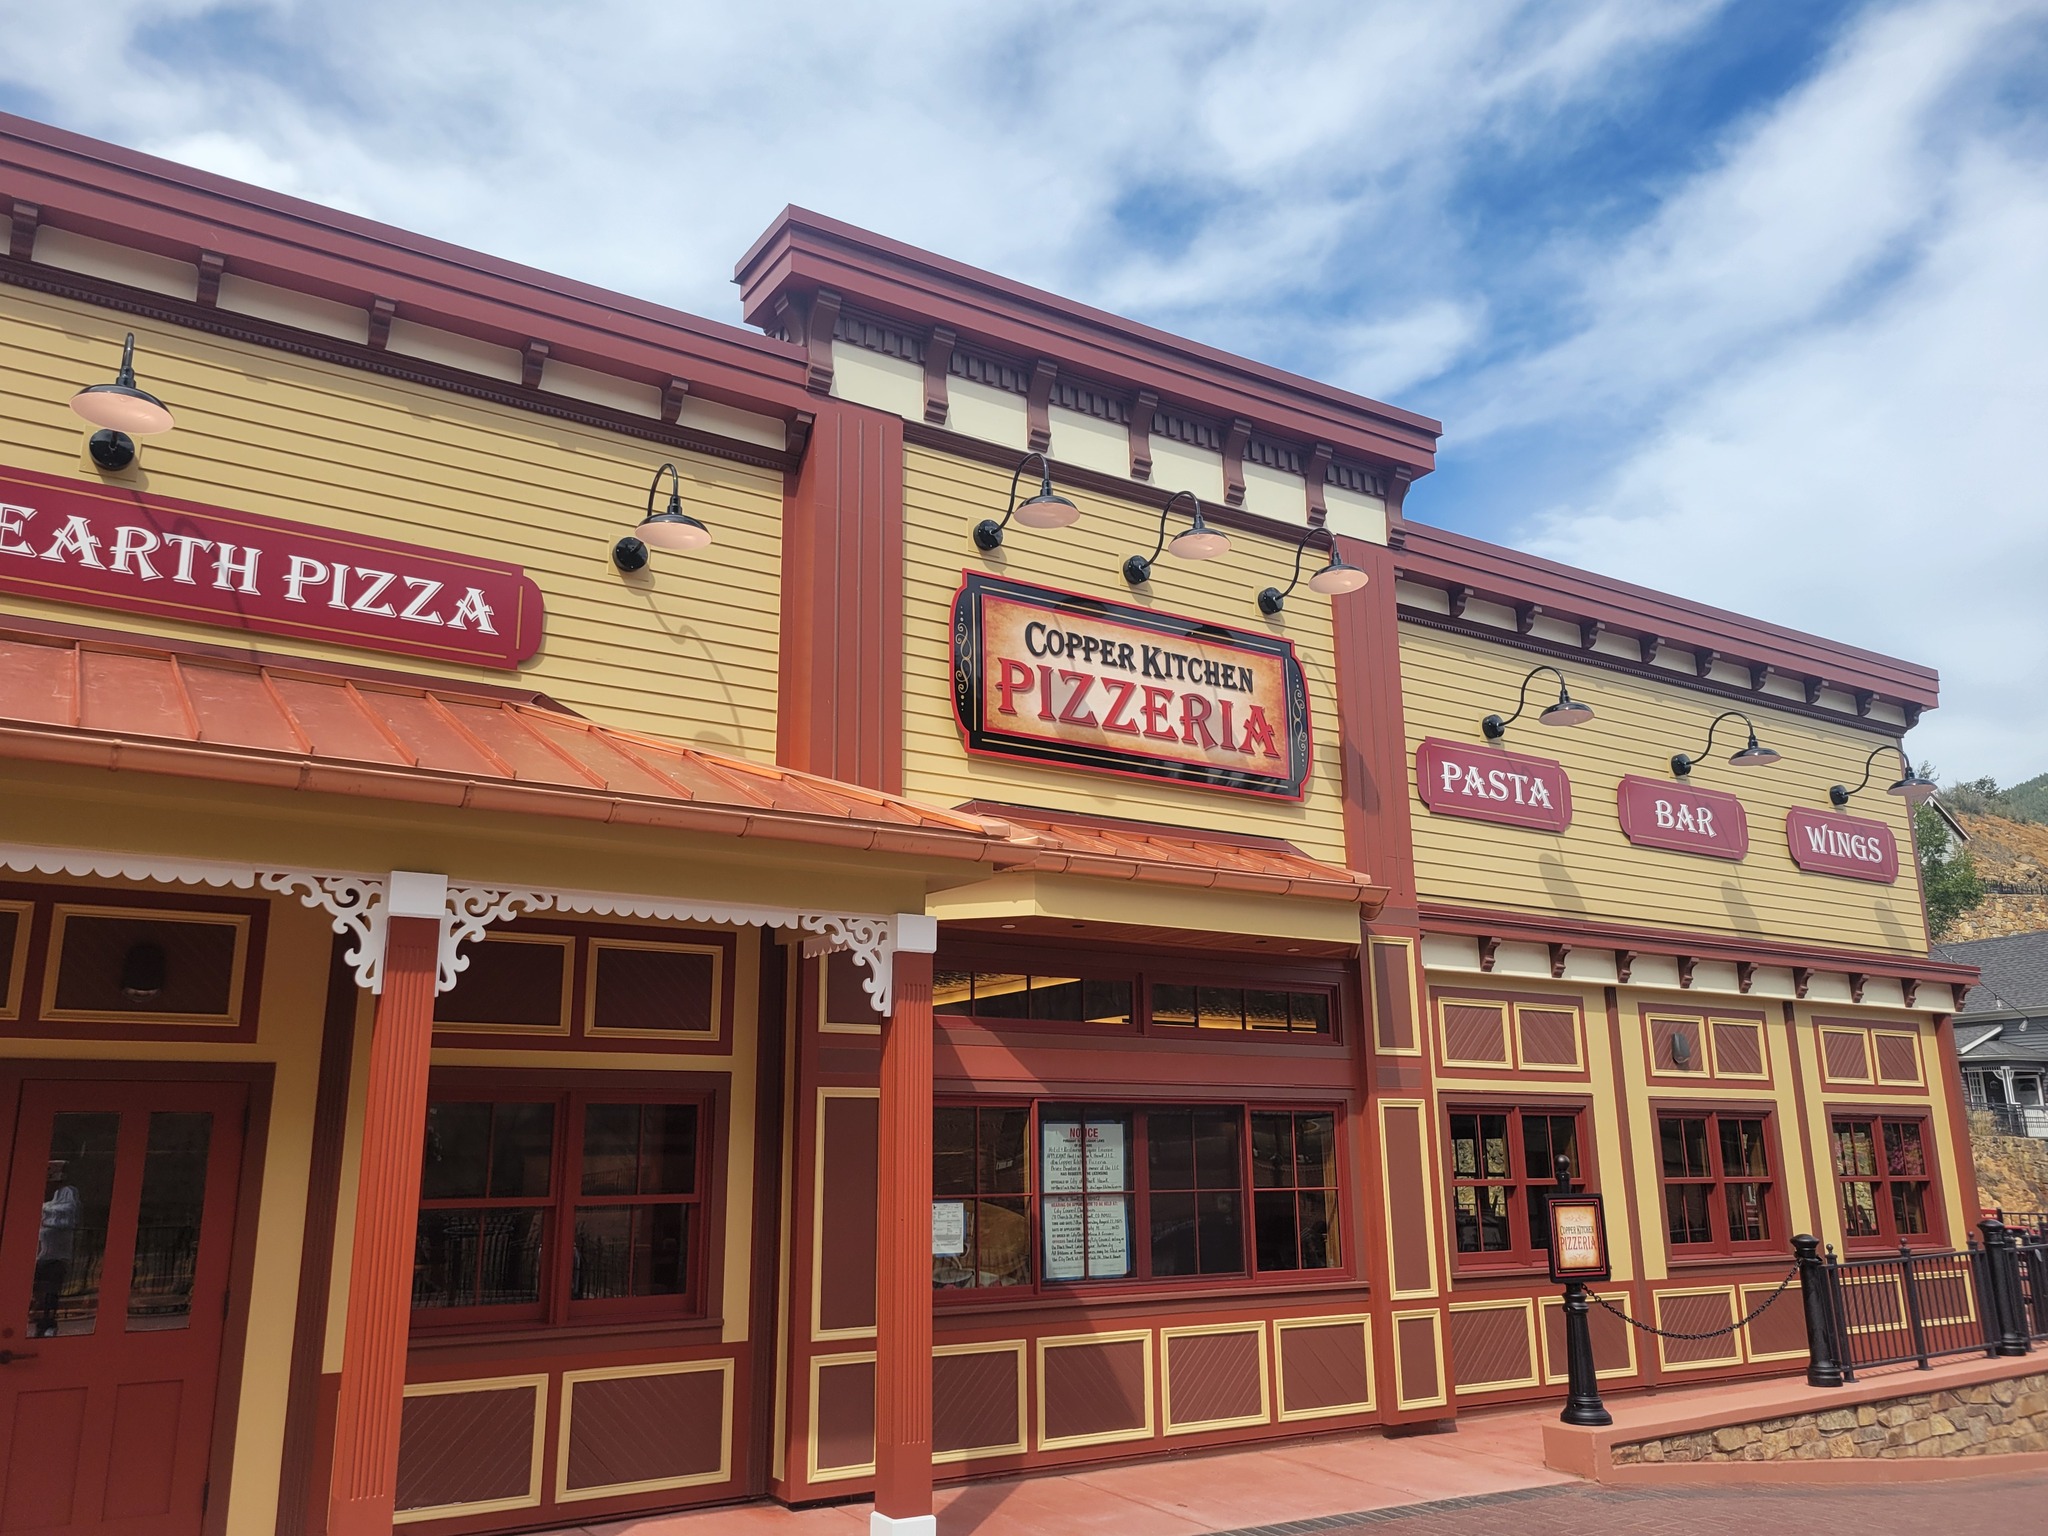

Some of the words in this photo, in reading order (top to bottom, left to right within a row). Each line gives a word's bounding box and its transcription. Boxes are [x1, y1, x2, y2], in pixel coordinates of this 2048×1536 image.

[281, 553, 500, 637] PIZZA
[1024, 621, 1138, 672] COPPER
[1141, 643, 1255, 694] KITCHEN
[994, 656, 1282, 759] PIZZERIA
[1440, 760, 1554, 811] PASTA
[1655, 799, 1718, 838] BAR
[1804, 823, 1884, 864] WINGS
[1560, 1236, 1597, 1251] PIZZERIA
